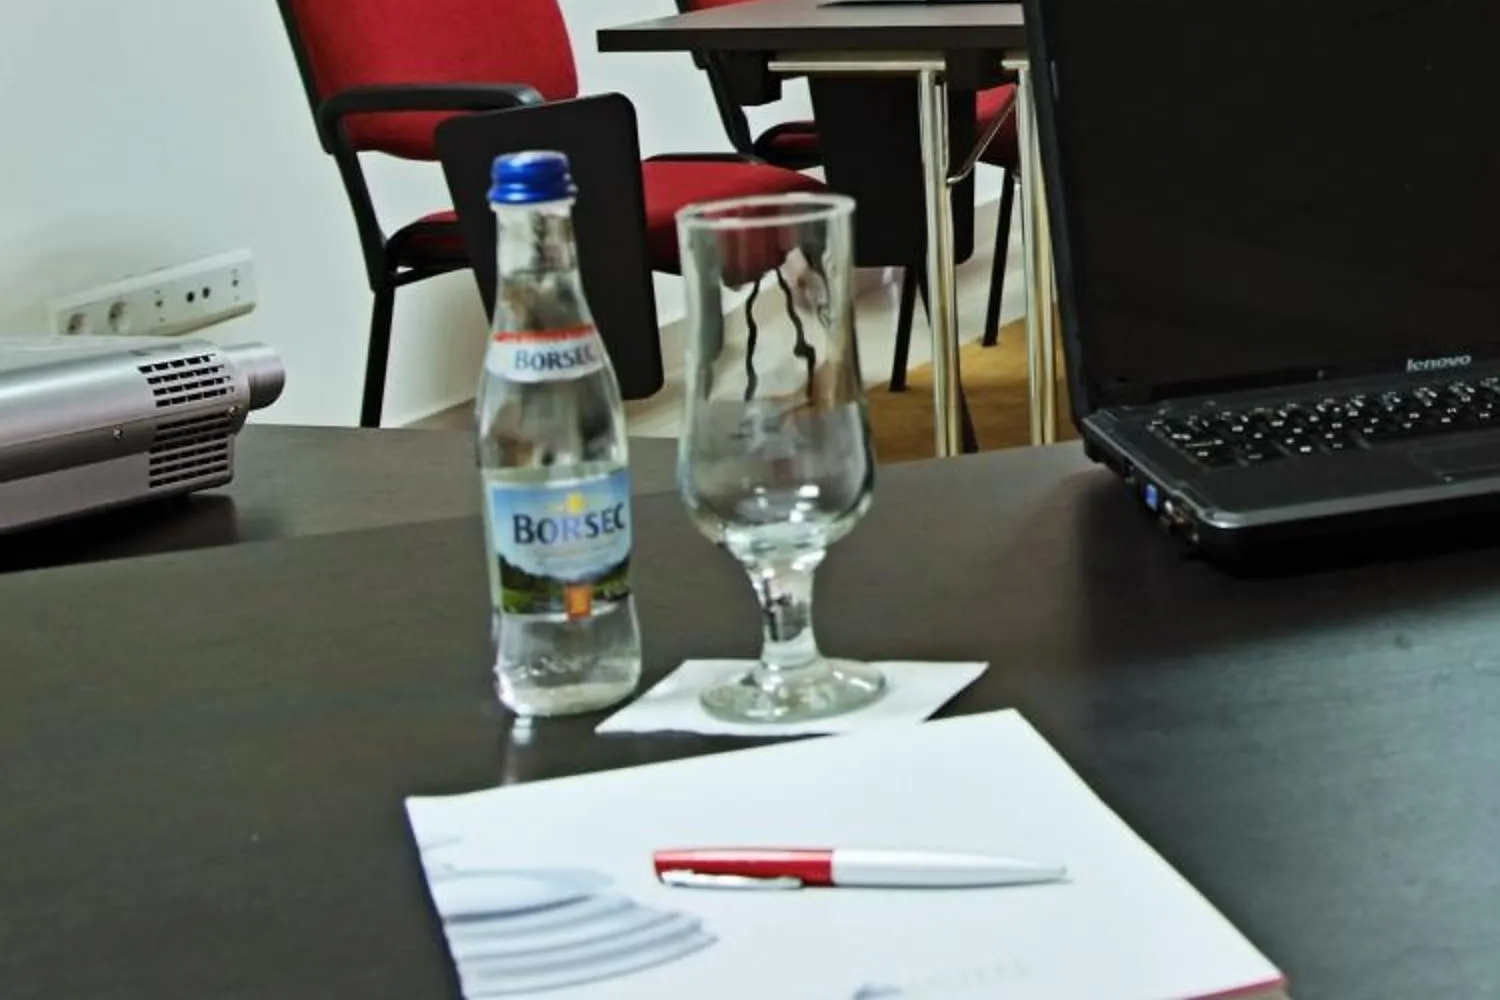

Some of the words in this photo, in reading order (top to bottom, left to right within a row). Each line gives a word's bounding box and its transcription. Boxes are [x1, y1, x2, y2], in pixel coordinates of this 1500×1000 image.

[514, 344, 598, 370] BORSEC
[1406, 355, 1472, 373] lenovo
[512, 502, 625, 544] BORSEC
